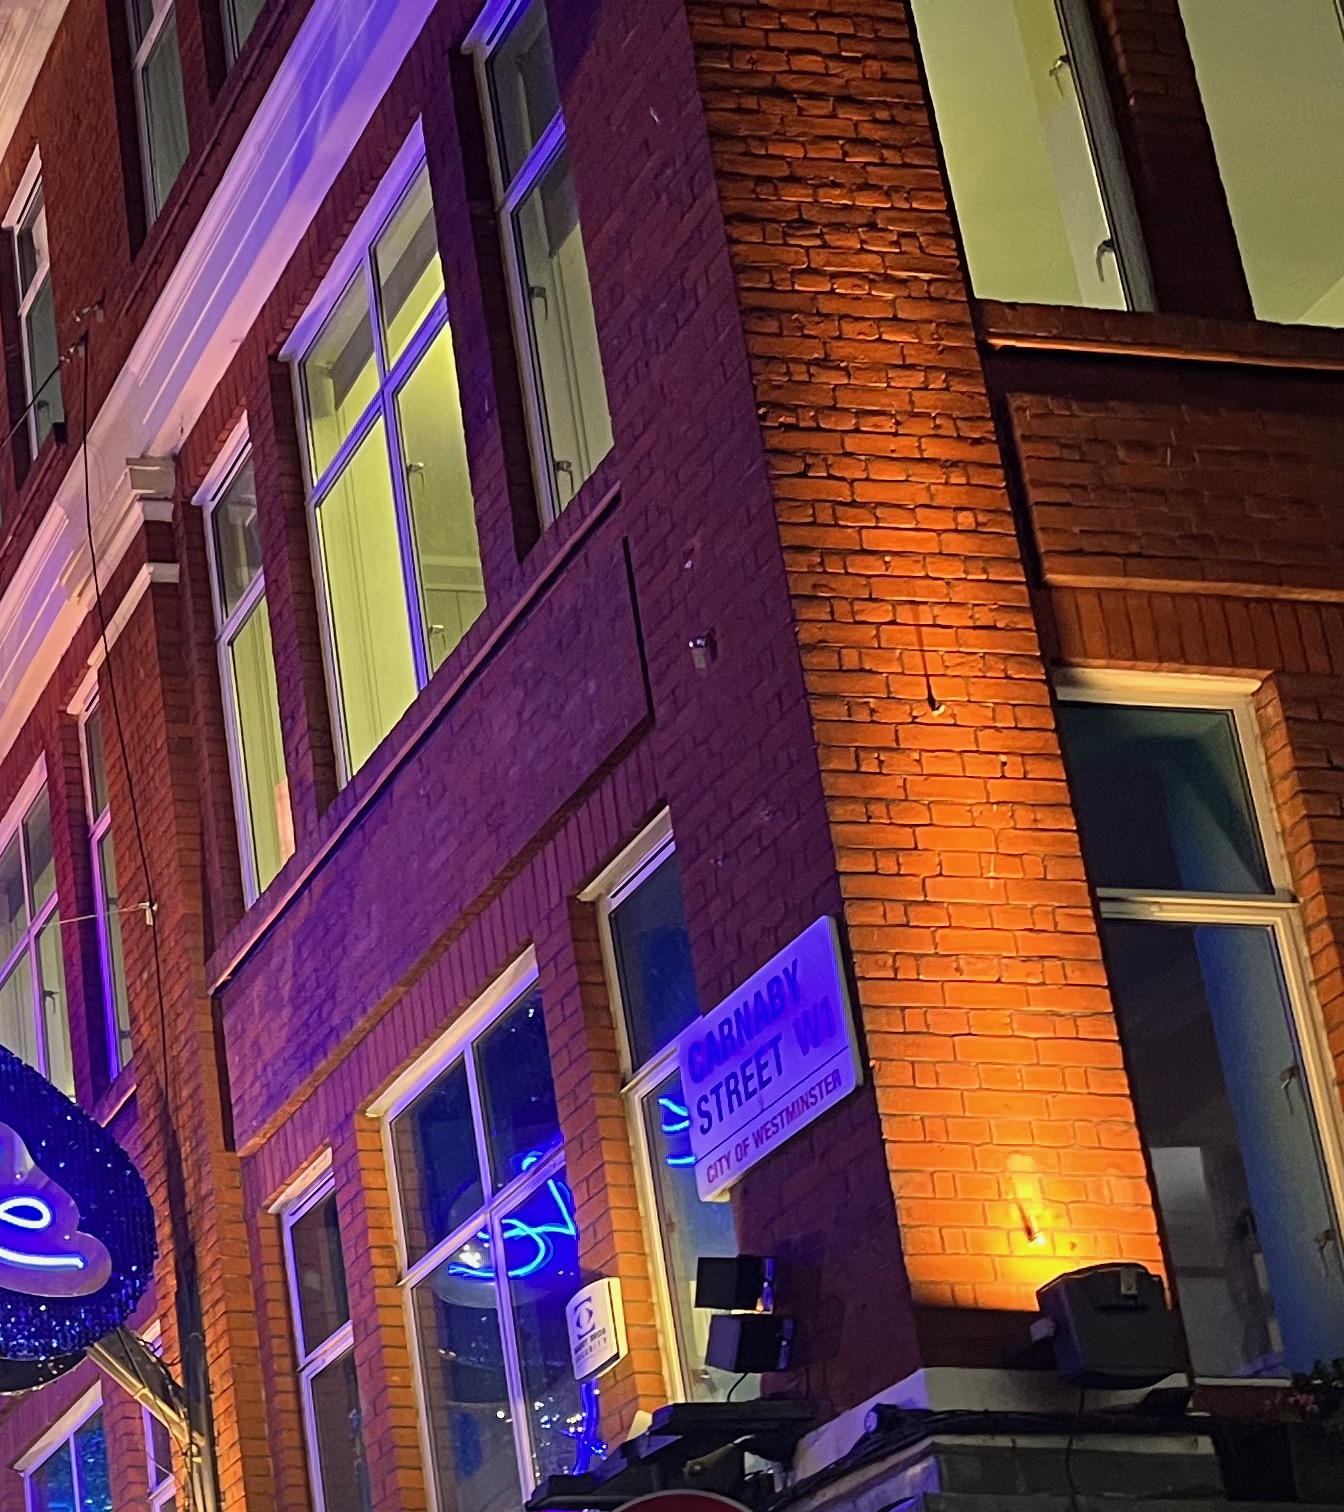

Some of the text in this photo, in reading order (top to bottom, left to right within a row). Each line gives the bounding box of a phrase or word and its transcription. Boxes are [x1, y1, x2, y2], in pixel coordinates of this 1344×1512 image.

[687, 957, 799, 1084] CARNABY
[696, 995, 837, 1136] STREET W1
[706, 1068, 842, 1184] CITY OF WESTMINSTER
